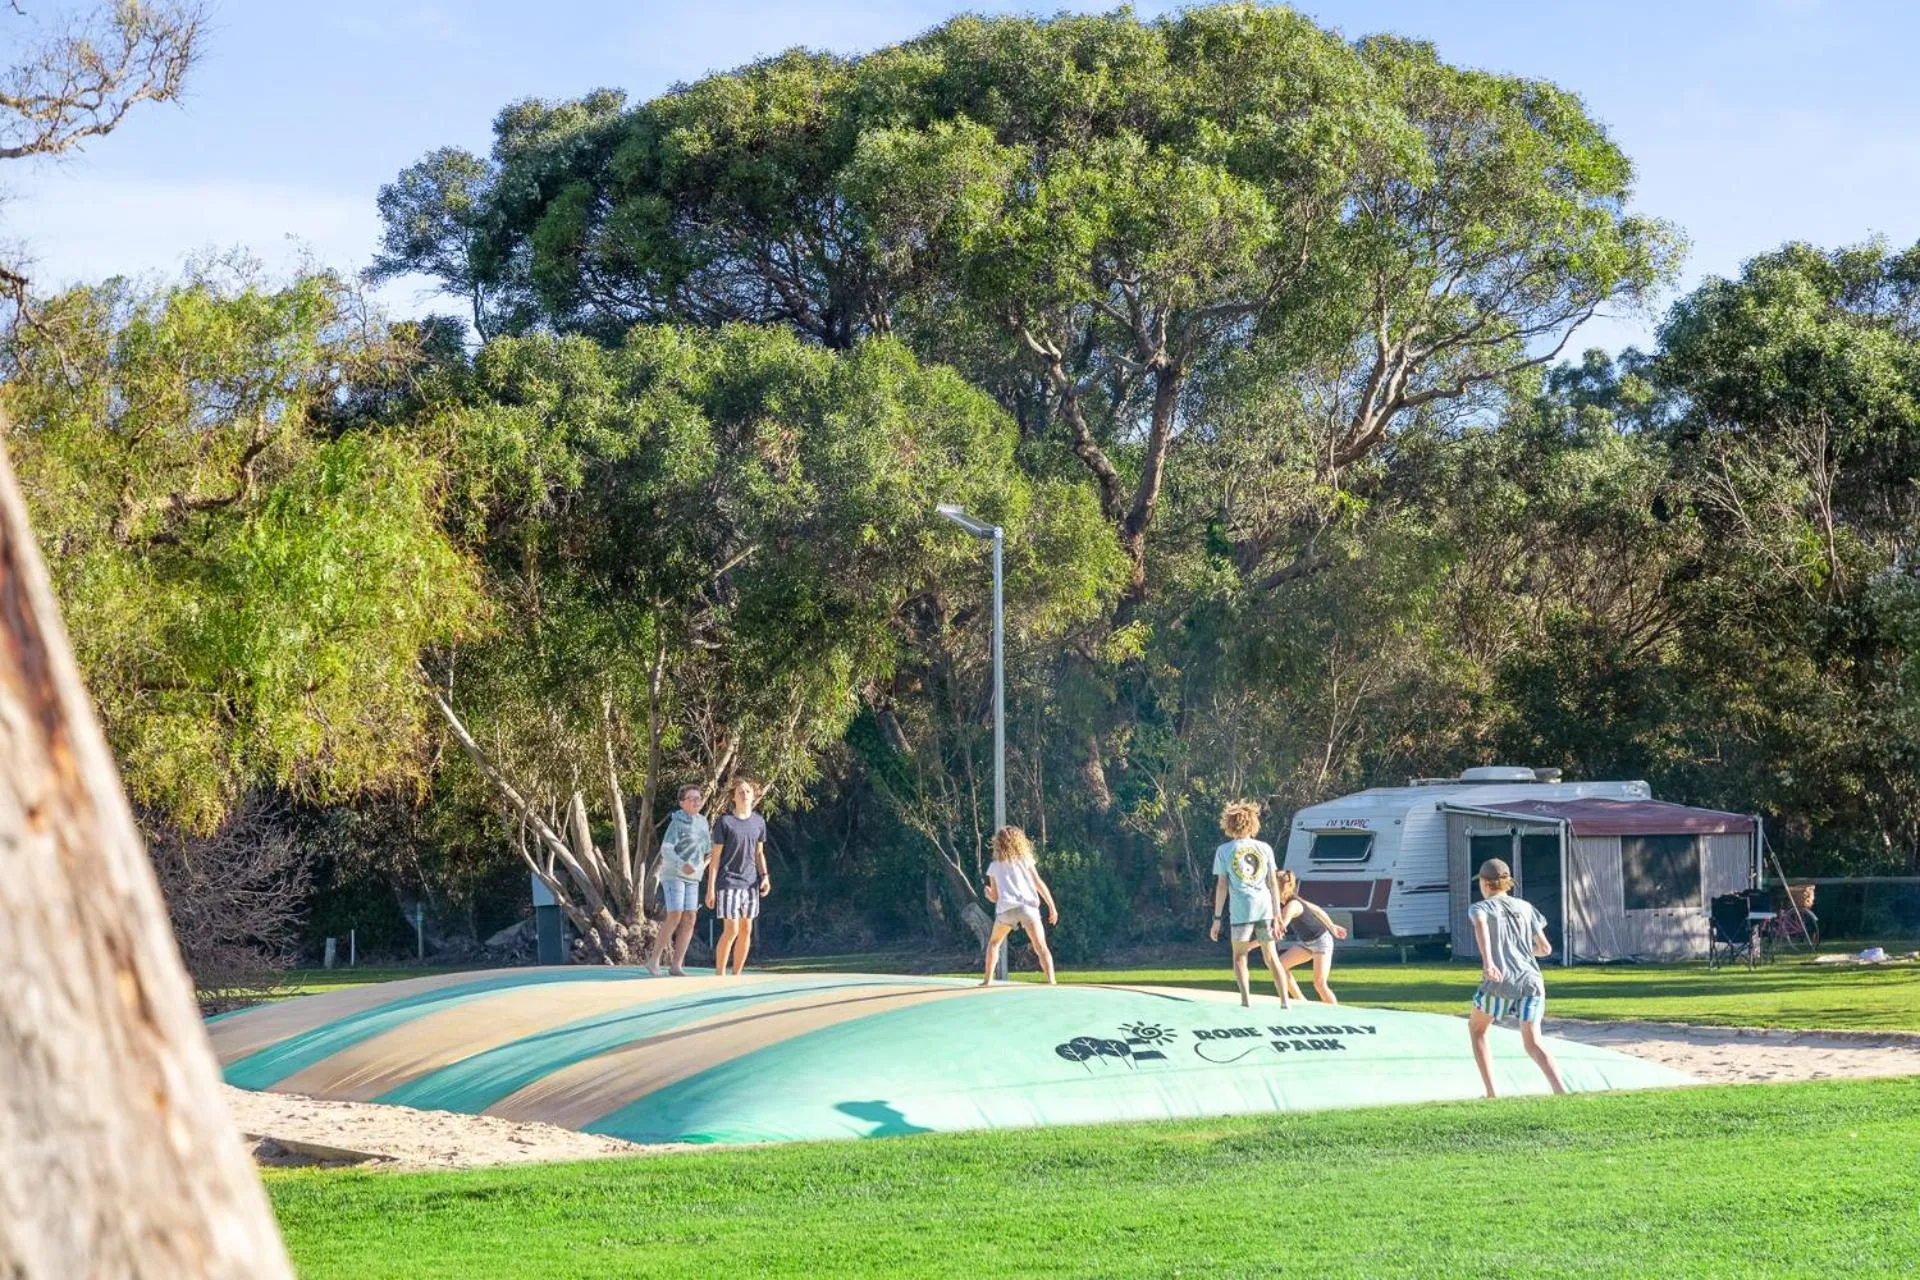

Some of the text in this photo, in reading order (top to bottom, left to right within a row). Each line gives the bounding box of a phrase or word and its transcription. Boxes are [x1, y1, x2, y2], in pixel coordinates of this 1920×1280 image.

[1192, 1025, 1377, 1041] ROBE HOLIDAY
[1270, 1038, 1347, 1053] PARK
